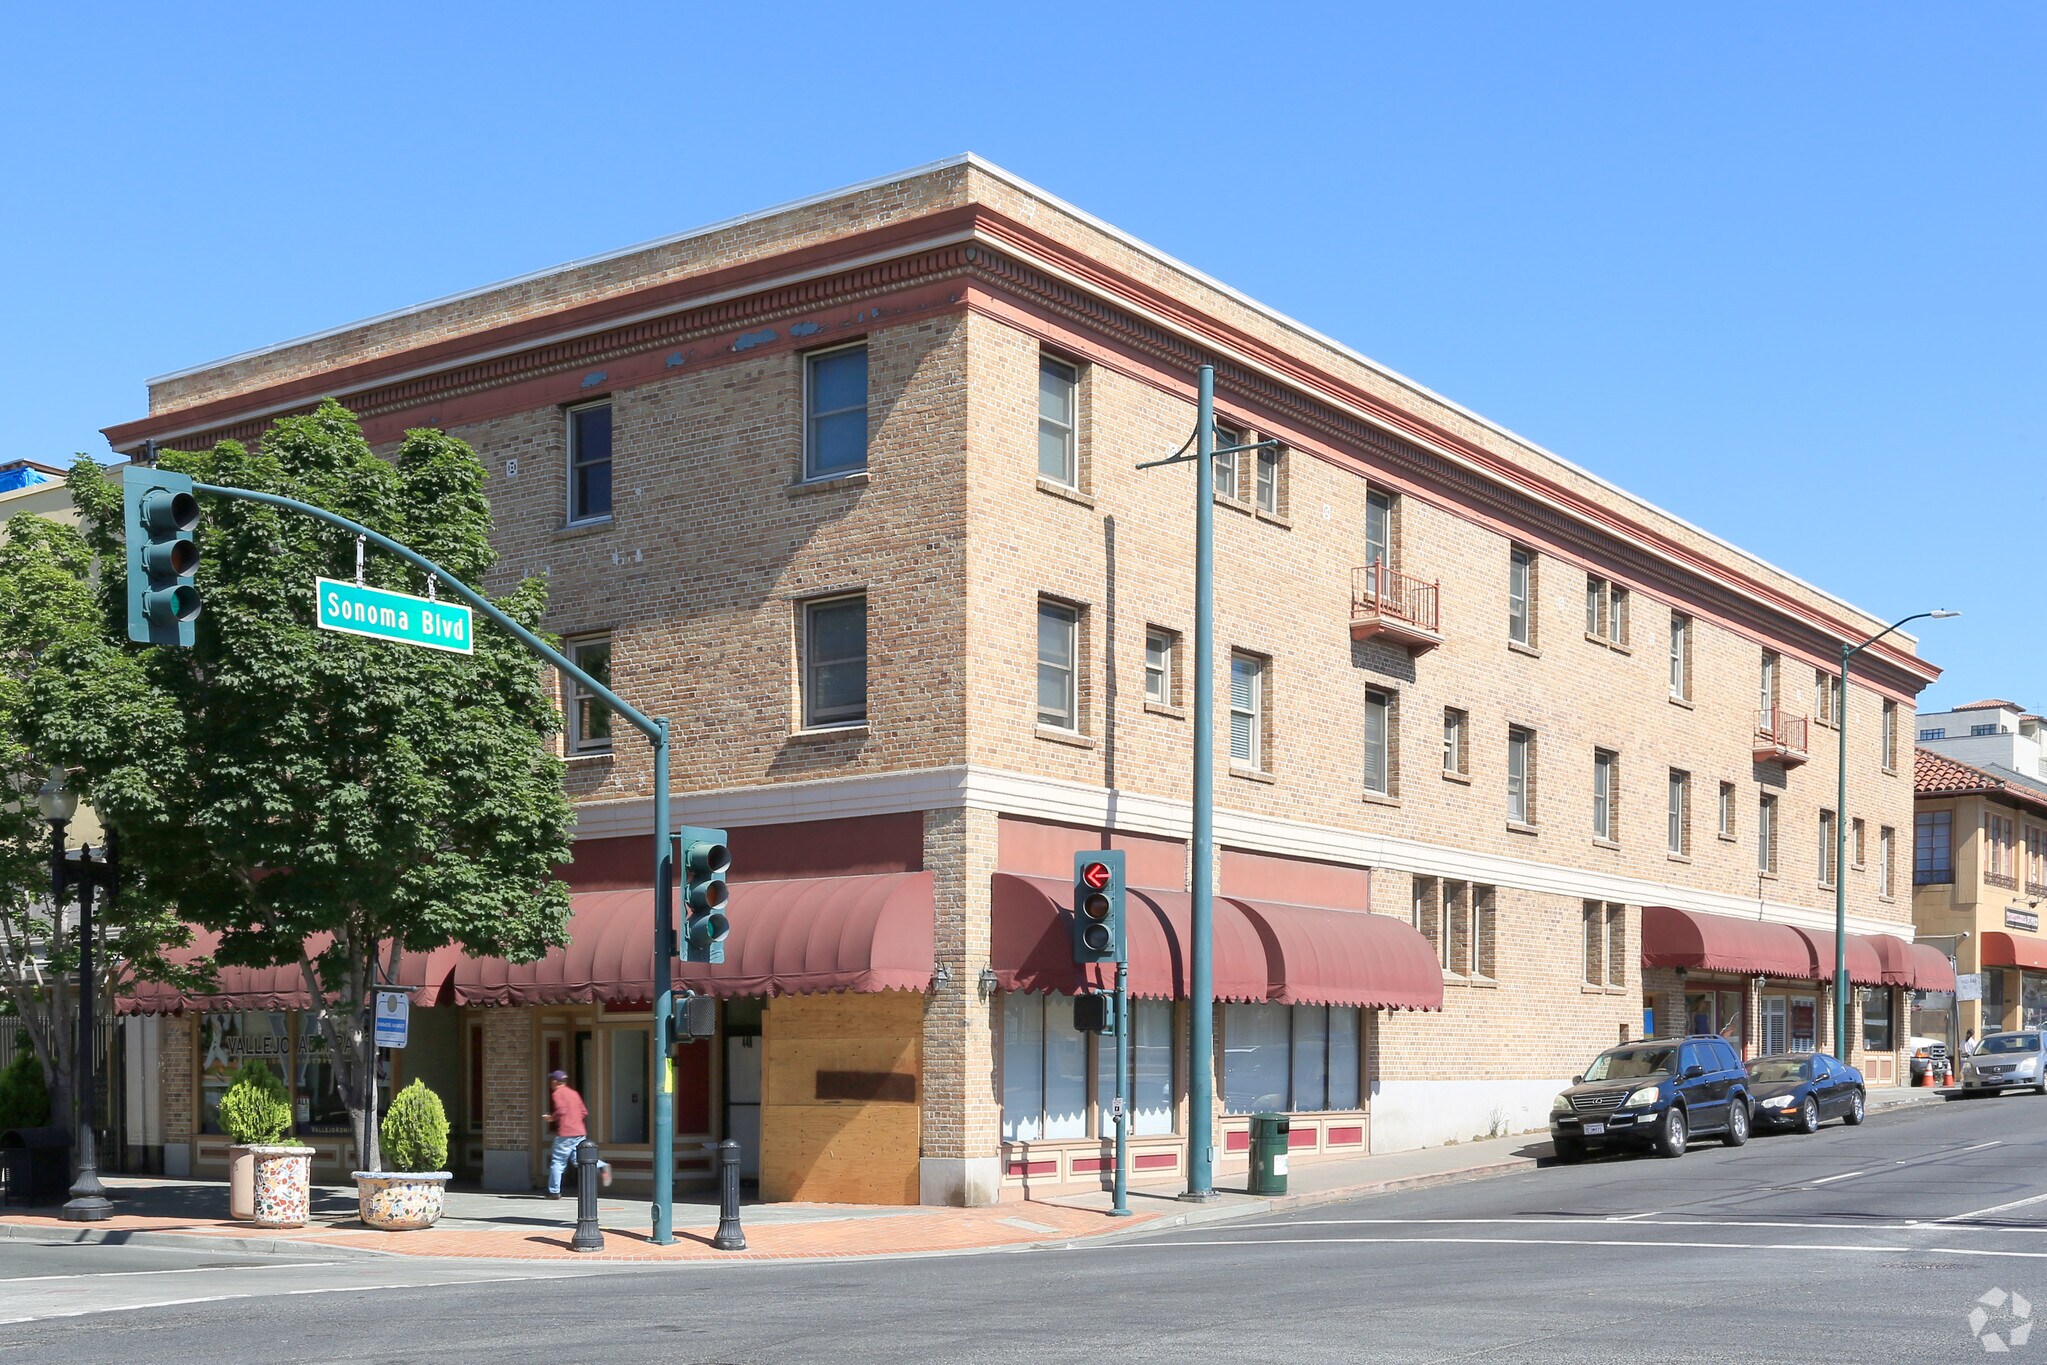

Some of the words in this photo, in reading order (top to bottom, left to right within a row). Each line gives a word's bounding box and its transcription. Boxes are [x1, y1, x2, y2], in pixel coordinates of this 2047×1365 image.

[328, 592, 409, 631] Sonoma
[422, 610, 464, 641] Blvd
[227, 1036, 289, 1056] VALLEJO
